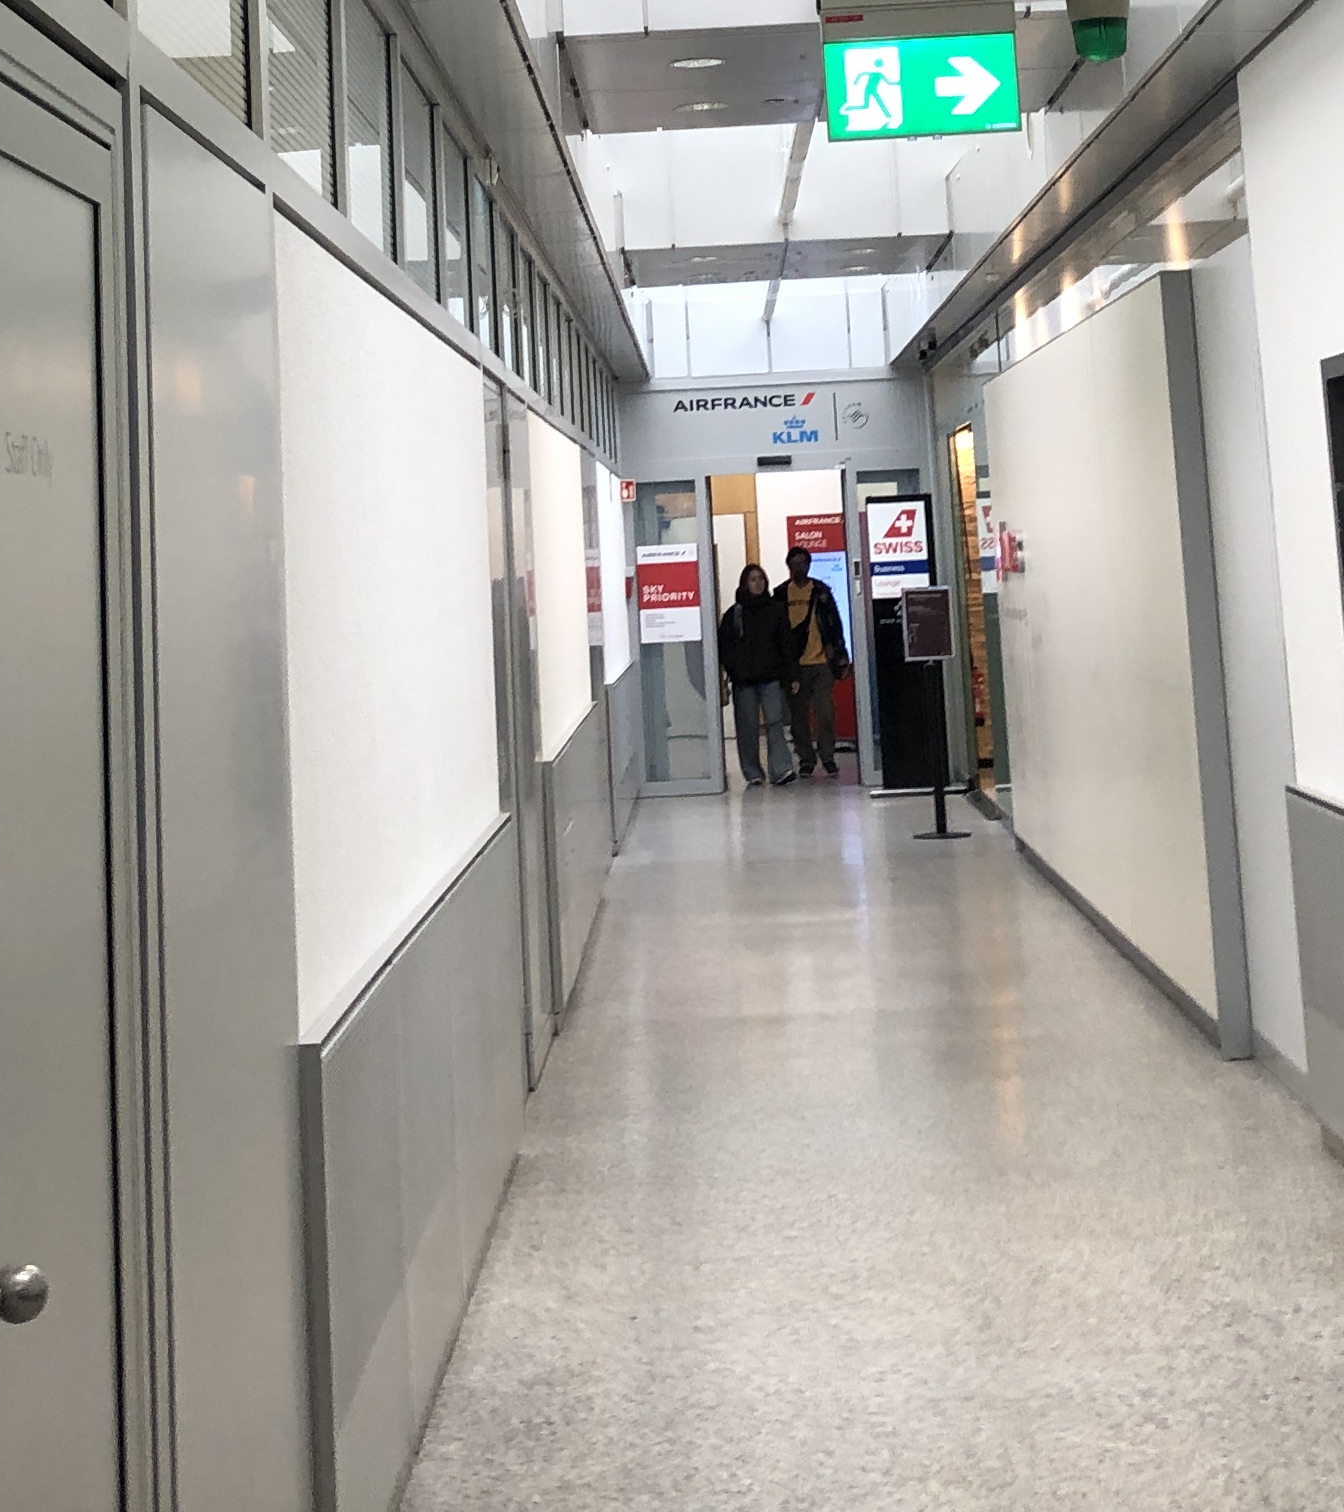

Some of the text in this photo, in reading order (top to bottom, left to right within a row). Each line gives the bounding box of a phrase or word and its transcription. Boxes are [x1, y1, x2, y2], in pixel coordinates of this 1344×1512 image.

[673, 393, 796, 413] AIRFRANCE
[772, 429, 819, 445] KLM
[794, 531, 823, 541] SALON
[873, 540, 924, 555] SWISS
[873, 564, 906, 574] Business
[642, 584, 665, 594] SKY
[643, 591, 695, 603] PRIORITY
